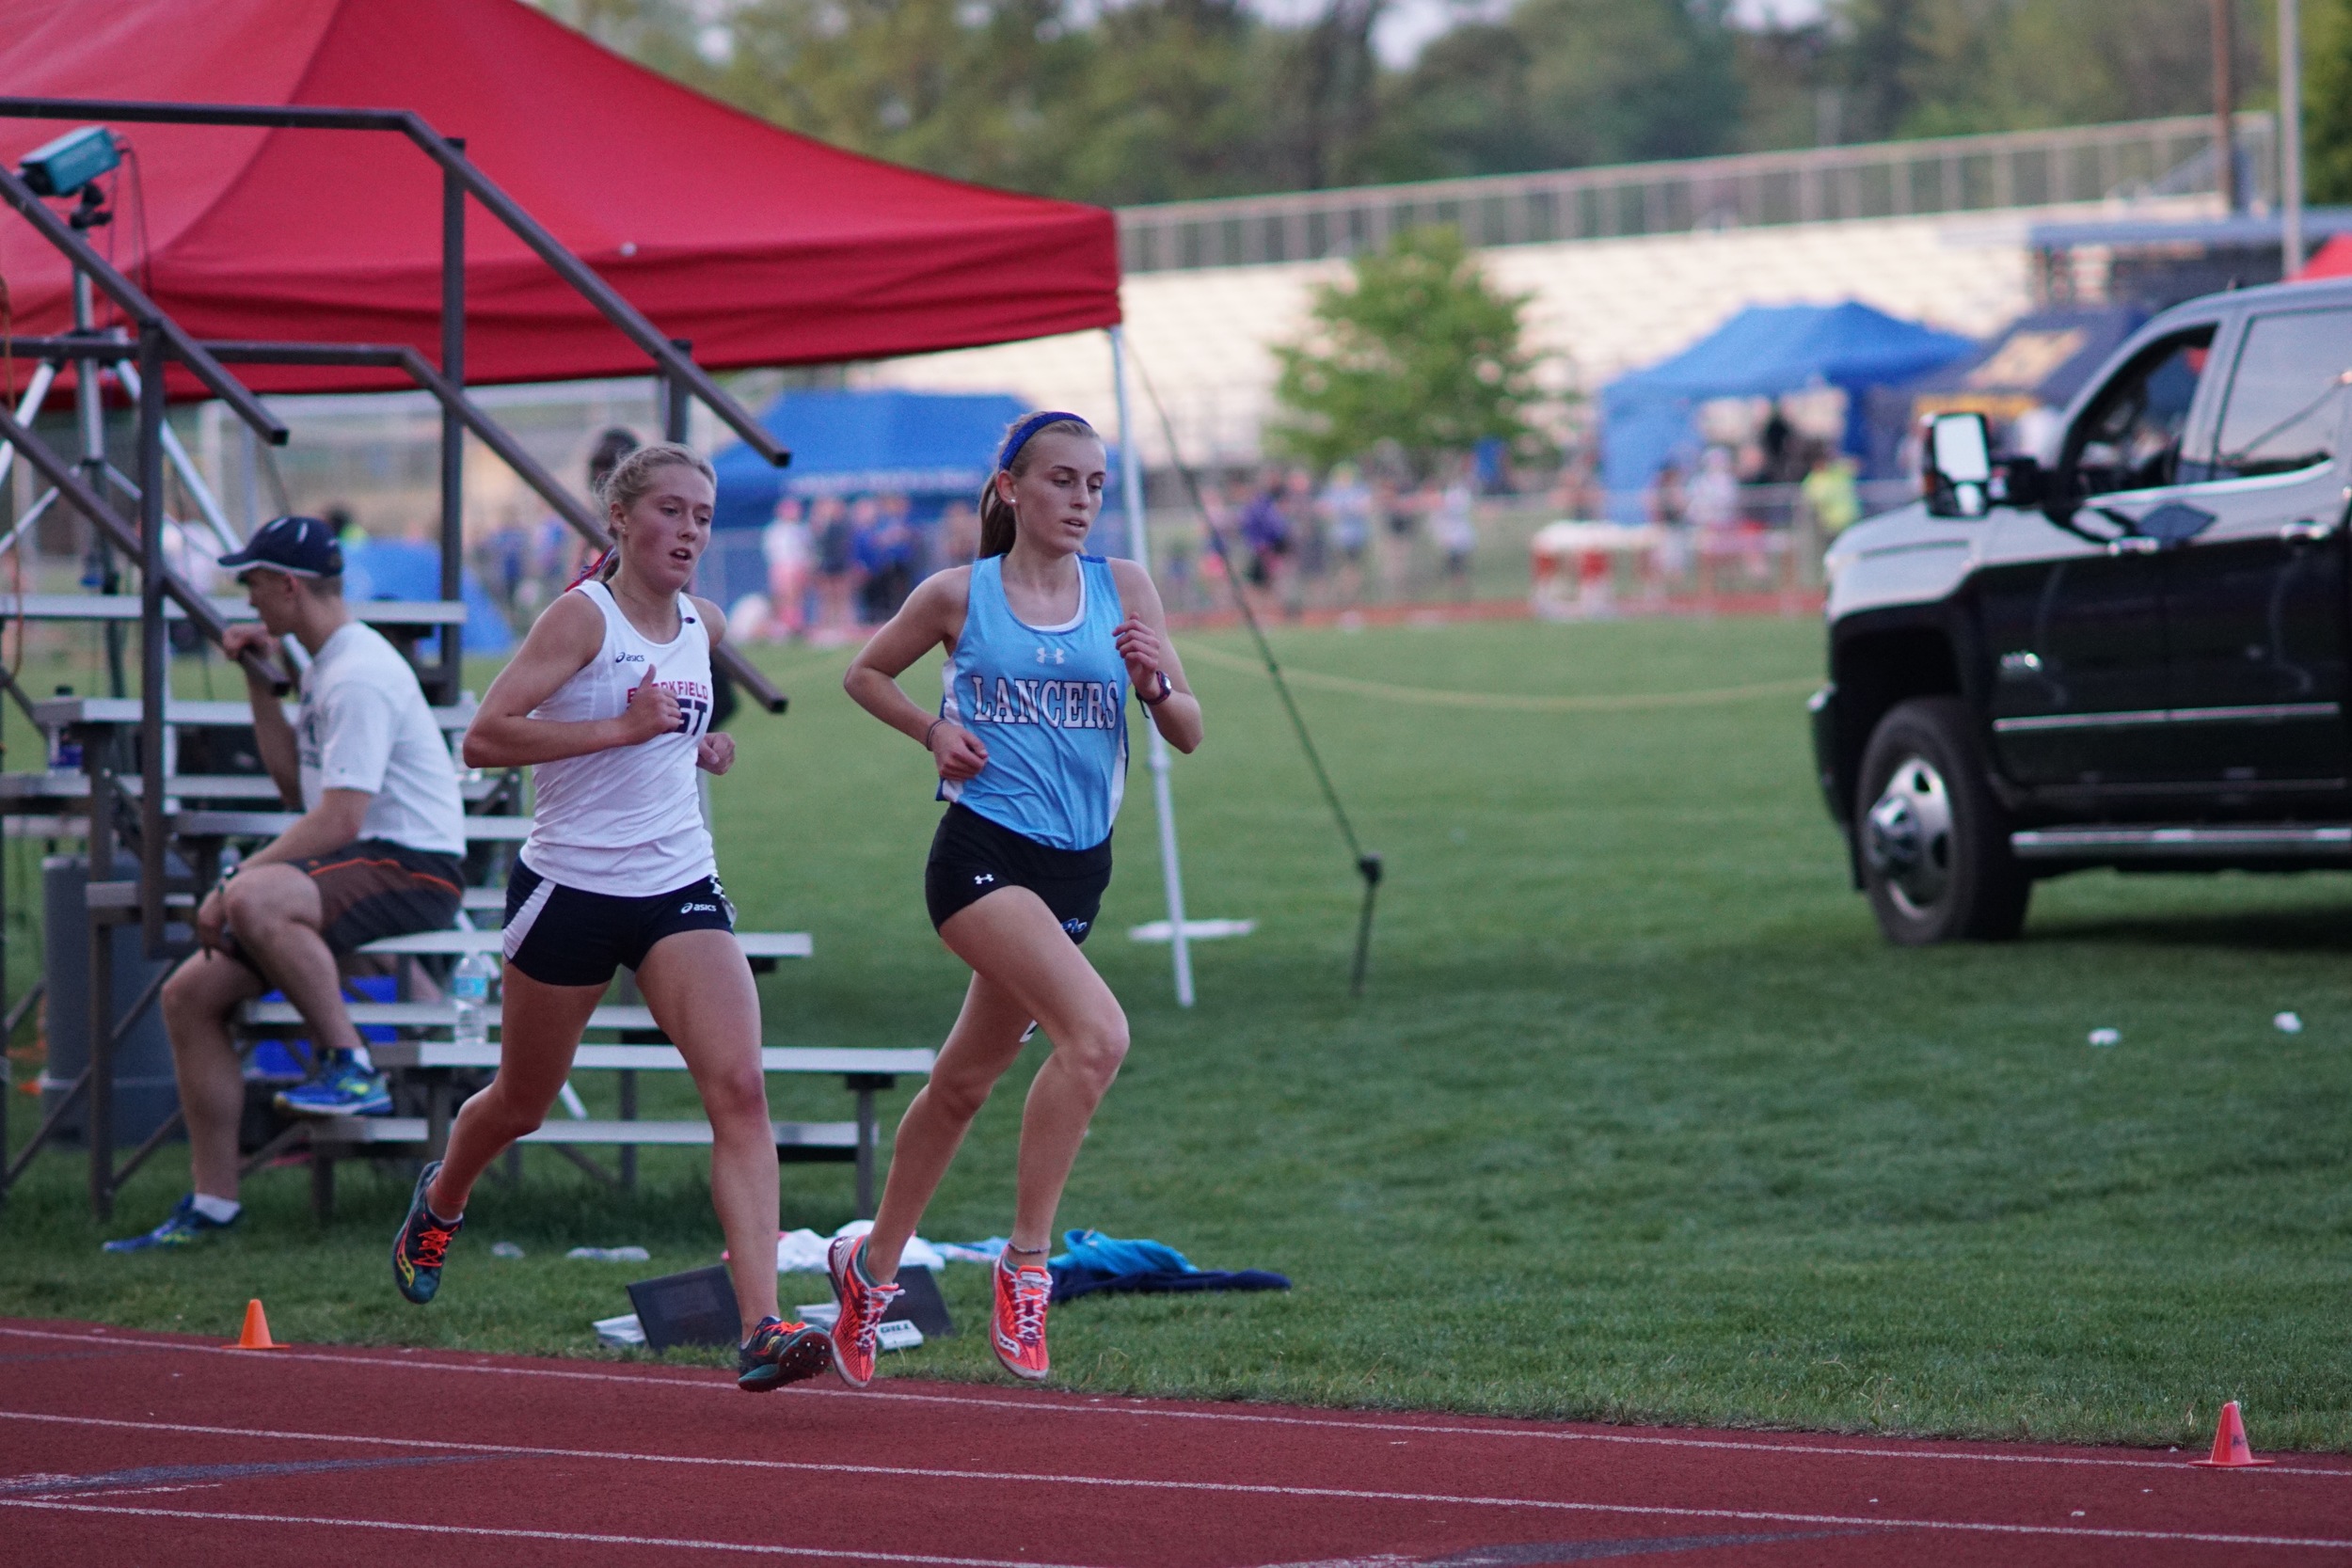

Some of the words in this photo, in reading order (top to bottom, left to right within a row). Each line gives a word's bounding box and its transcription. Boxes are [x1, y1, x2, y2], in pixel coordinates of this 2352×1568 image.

[626, 654, 644, 662] asics
[627, 681, 708, 704] BKFIELD
[972, 675, 1120, 730] LANCERS
[693, 903, 717, 911] asics
